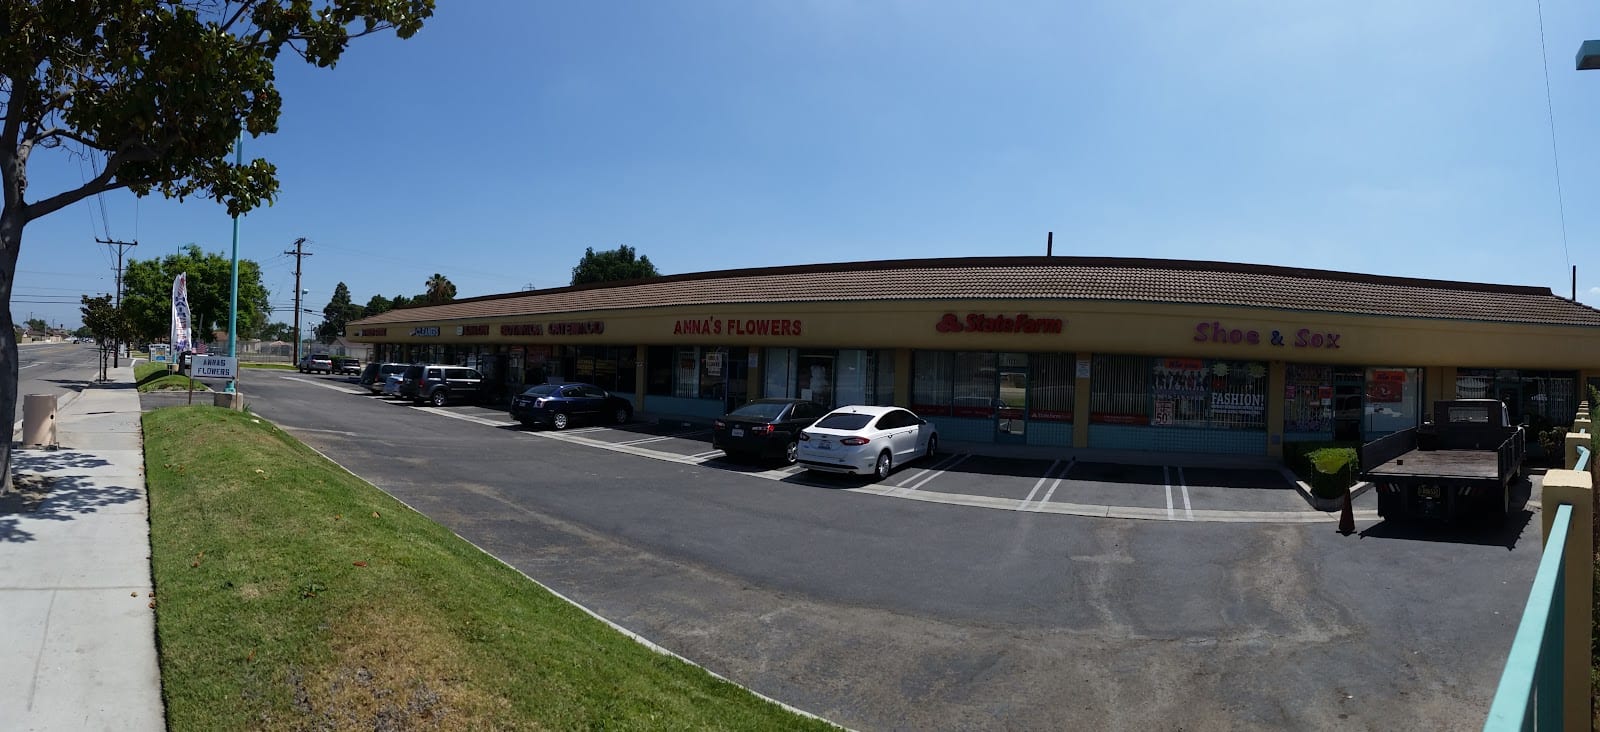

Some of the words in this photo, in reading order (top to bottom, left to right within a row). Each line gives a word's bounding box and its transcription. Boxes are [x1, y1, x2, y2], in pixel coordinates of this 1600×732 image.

[673, 315, 722, 335] ANNA'S
[727, 319, 802, 336] FLOWERS
[1194, 321, 1260, 345] Shoe
[1270, 330, 1285, 346] &
[1294, 328, 1341, 349] Sox
[197, 367, 230, 376] FLOWERS
[1211, 392, 1265, 407] FASHION!
